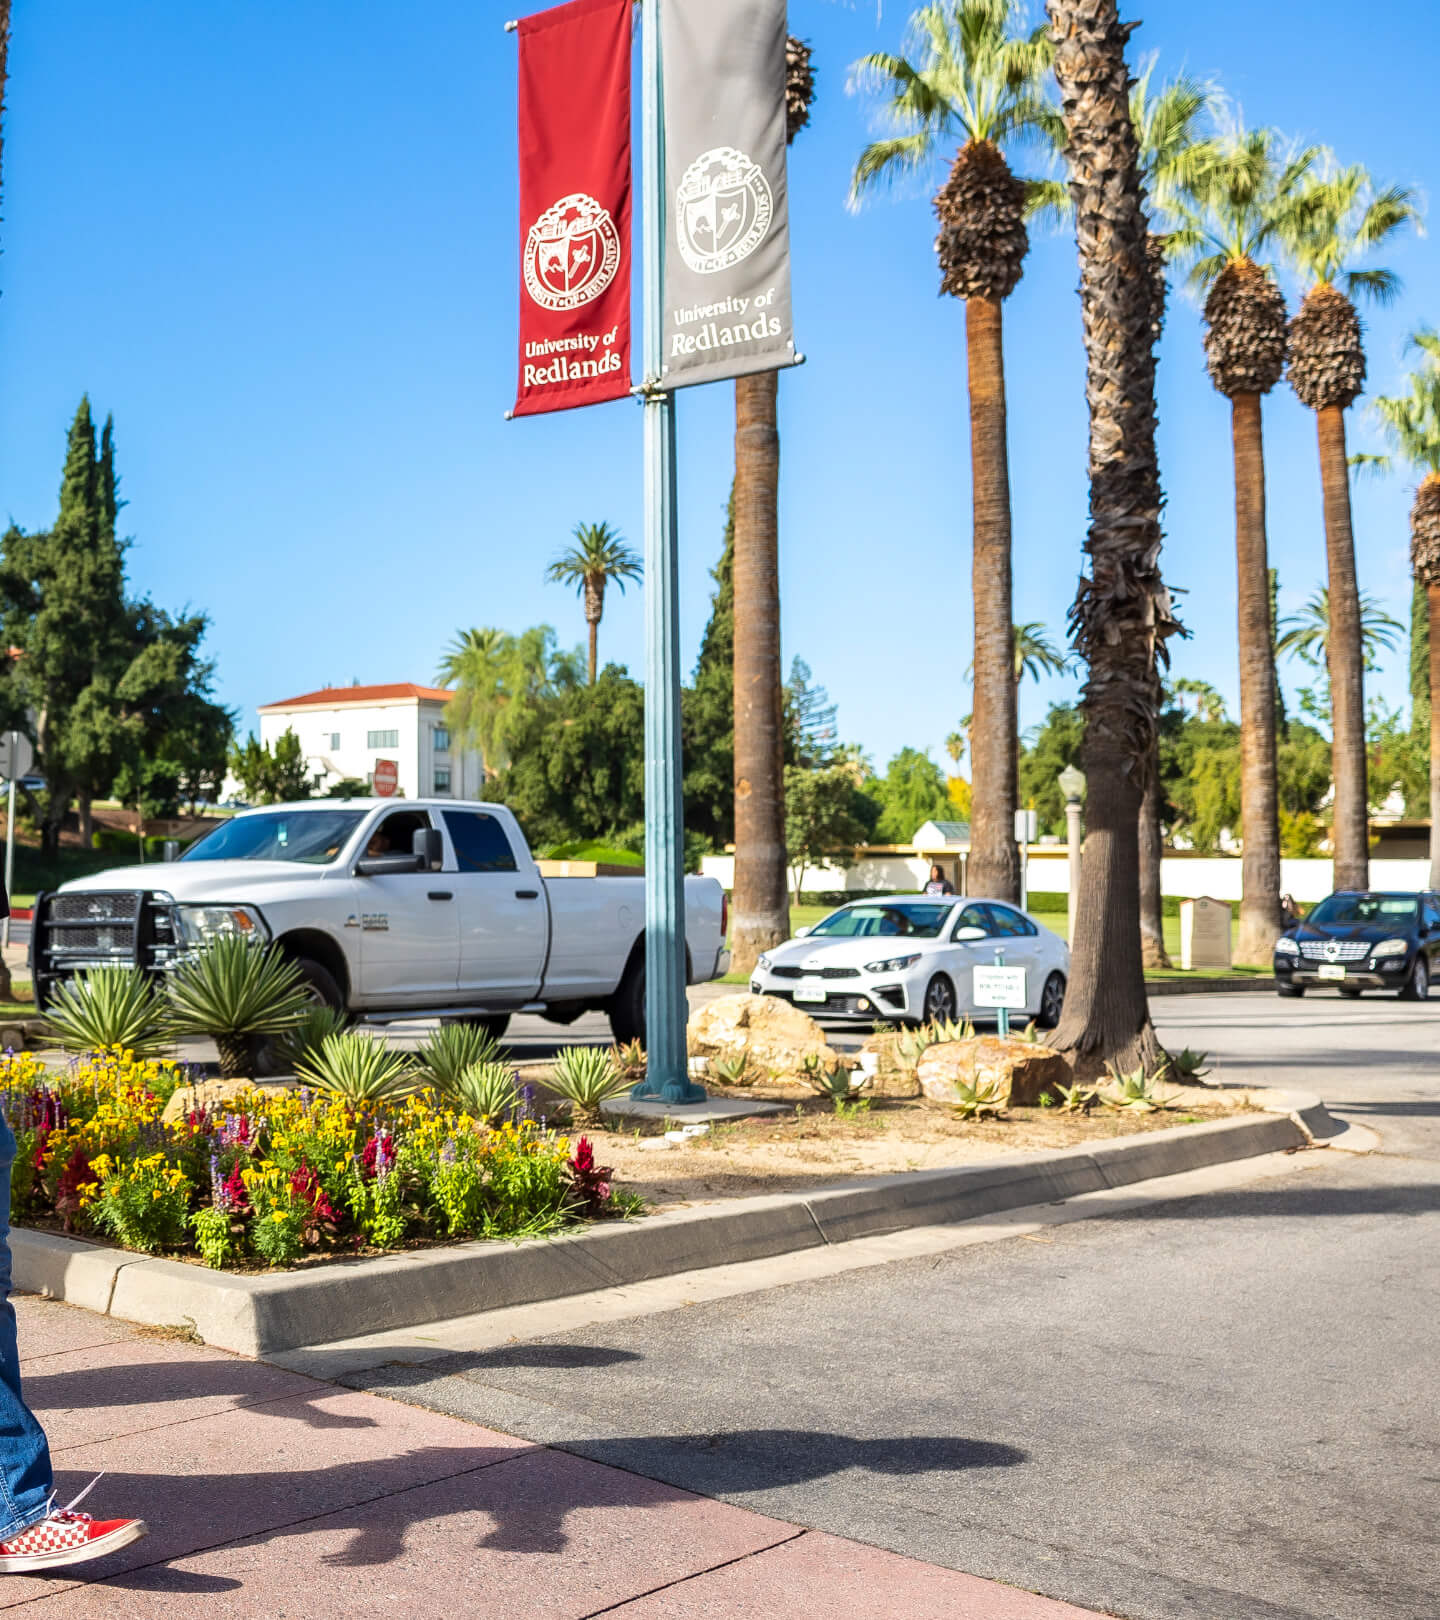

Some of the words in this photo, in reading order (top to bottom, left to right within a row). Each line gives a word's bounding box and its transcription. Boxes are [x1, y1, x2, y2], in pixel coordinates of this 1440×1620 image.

[584, 236, 619, 299] REDLANDS
[673, 296, 750, 326] University
[753, 288, 775, 307] of
[525, 333, 599, 358] University
[602, 325, 619, 346] of
[670, 312, 782, 357] Redlands
[523, 349, 622, 387] Redlands
